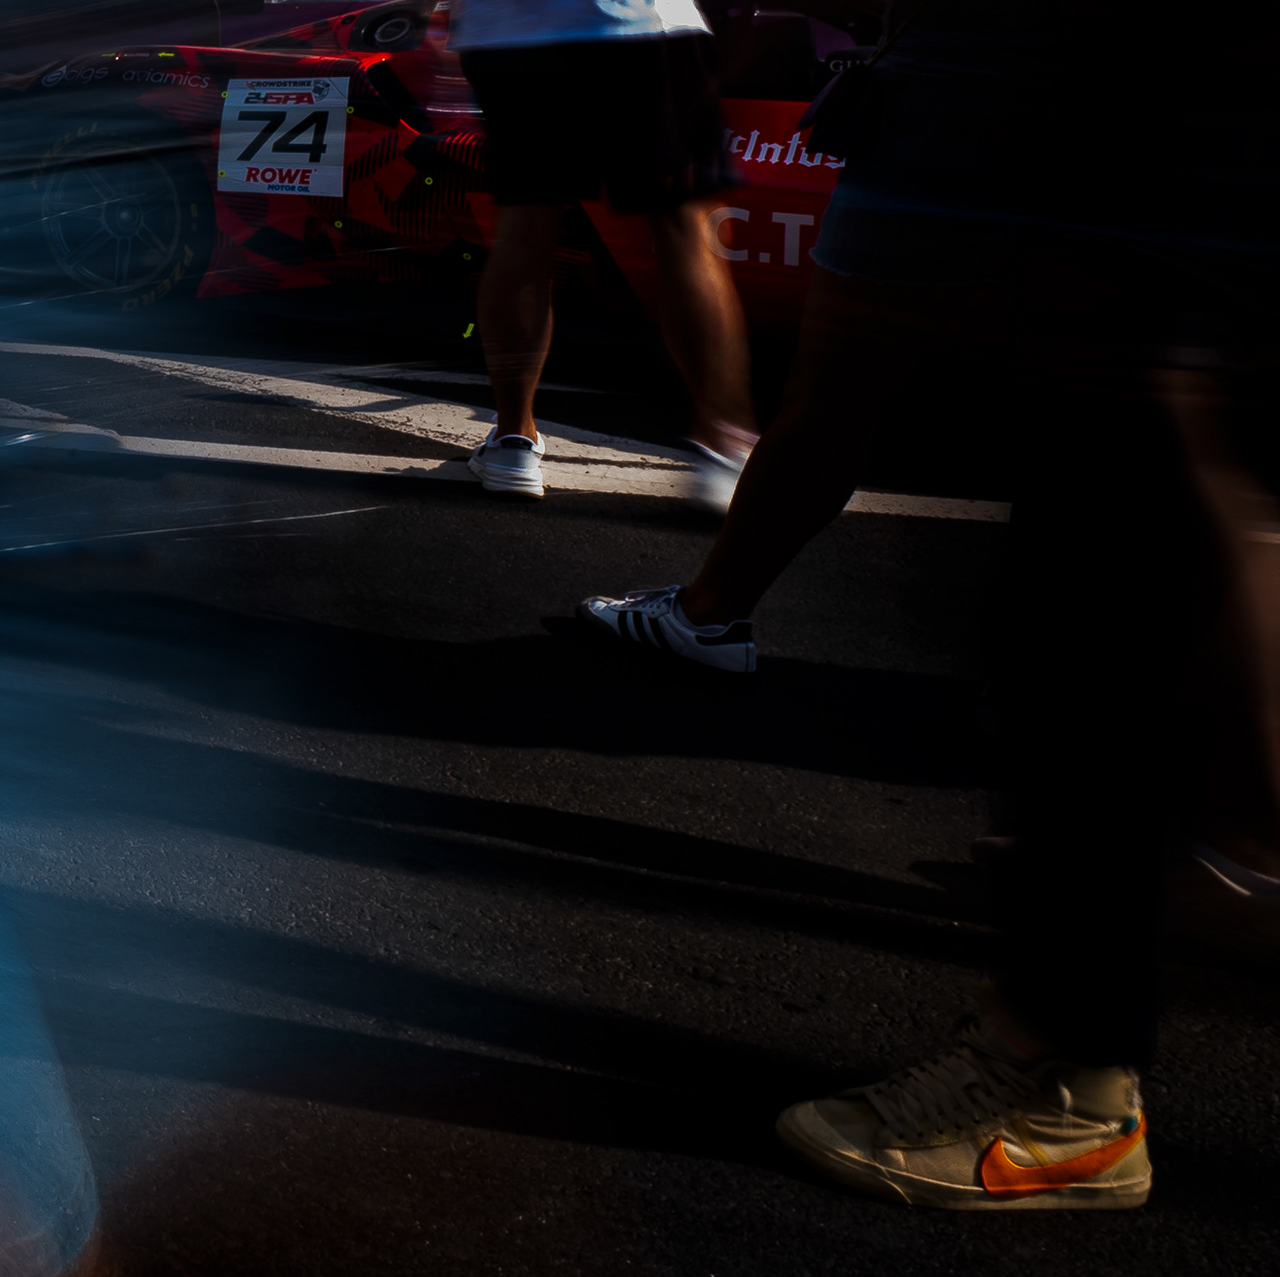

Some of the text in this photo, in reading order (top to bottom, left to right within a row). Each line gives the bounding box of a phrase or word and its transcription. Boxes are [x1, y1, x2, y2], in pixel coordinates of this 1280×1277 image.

[122, 67, 210, 89] aviamics
[251, 79, 311, 89] CROWDSTRIKE
[236, 110, 329, 163] 74
[245, 166, 312, 185] ROWE
[267, 184, 311, 193] MOTOR OIL
